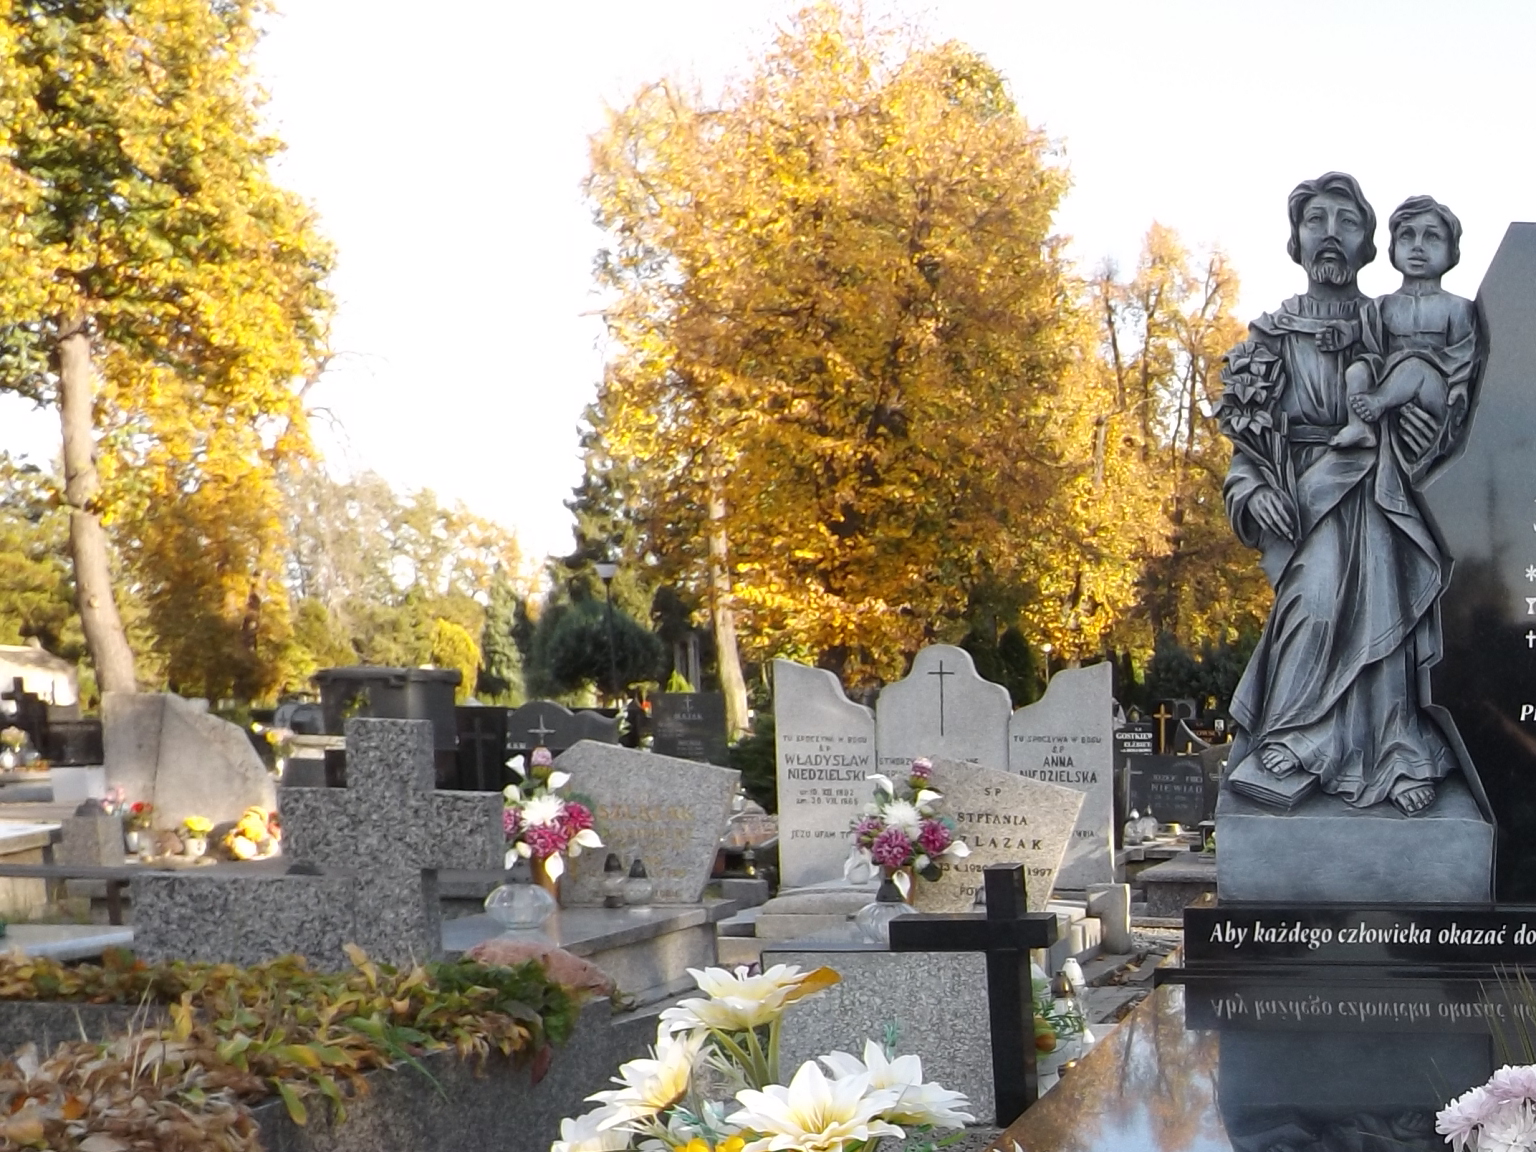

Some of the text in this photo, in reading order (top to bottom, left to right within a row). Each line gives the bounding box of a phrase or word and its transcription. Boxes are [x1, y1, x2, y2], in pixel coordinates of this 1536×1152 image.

[1043, 756, 1074, 767] ANNA
[787, 768, 866, 781] NIEDZIELSKI
[1209, 920, 1248, 949] Aby
[1254, 921, 1333, 950] każdego
[1338, 921, 1431, 944] człowieka
[1438, 922, 1507, 945] okazać
